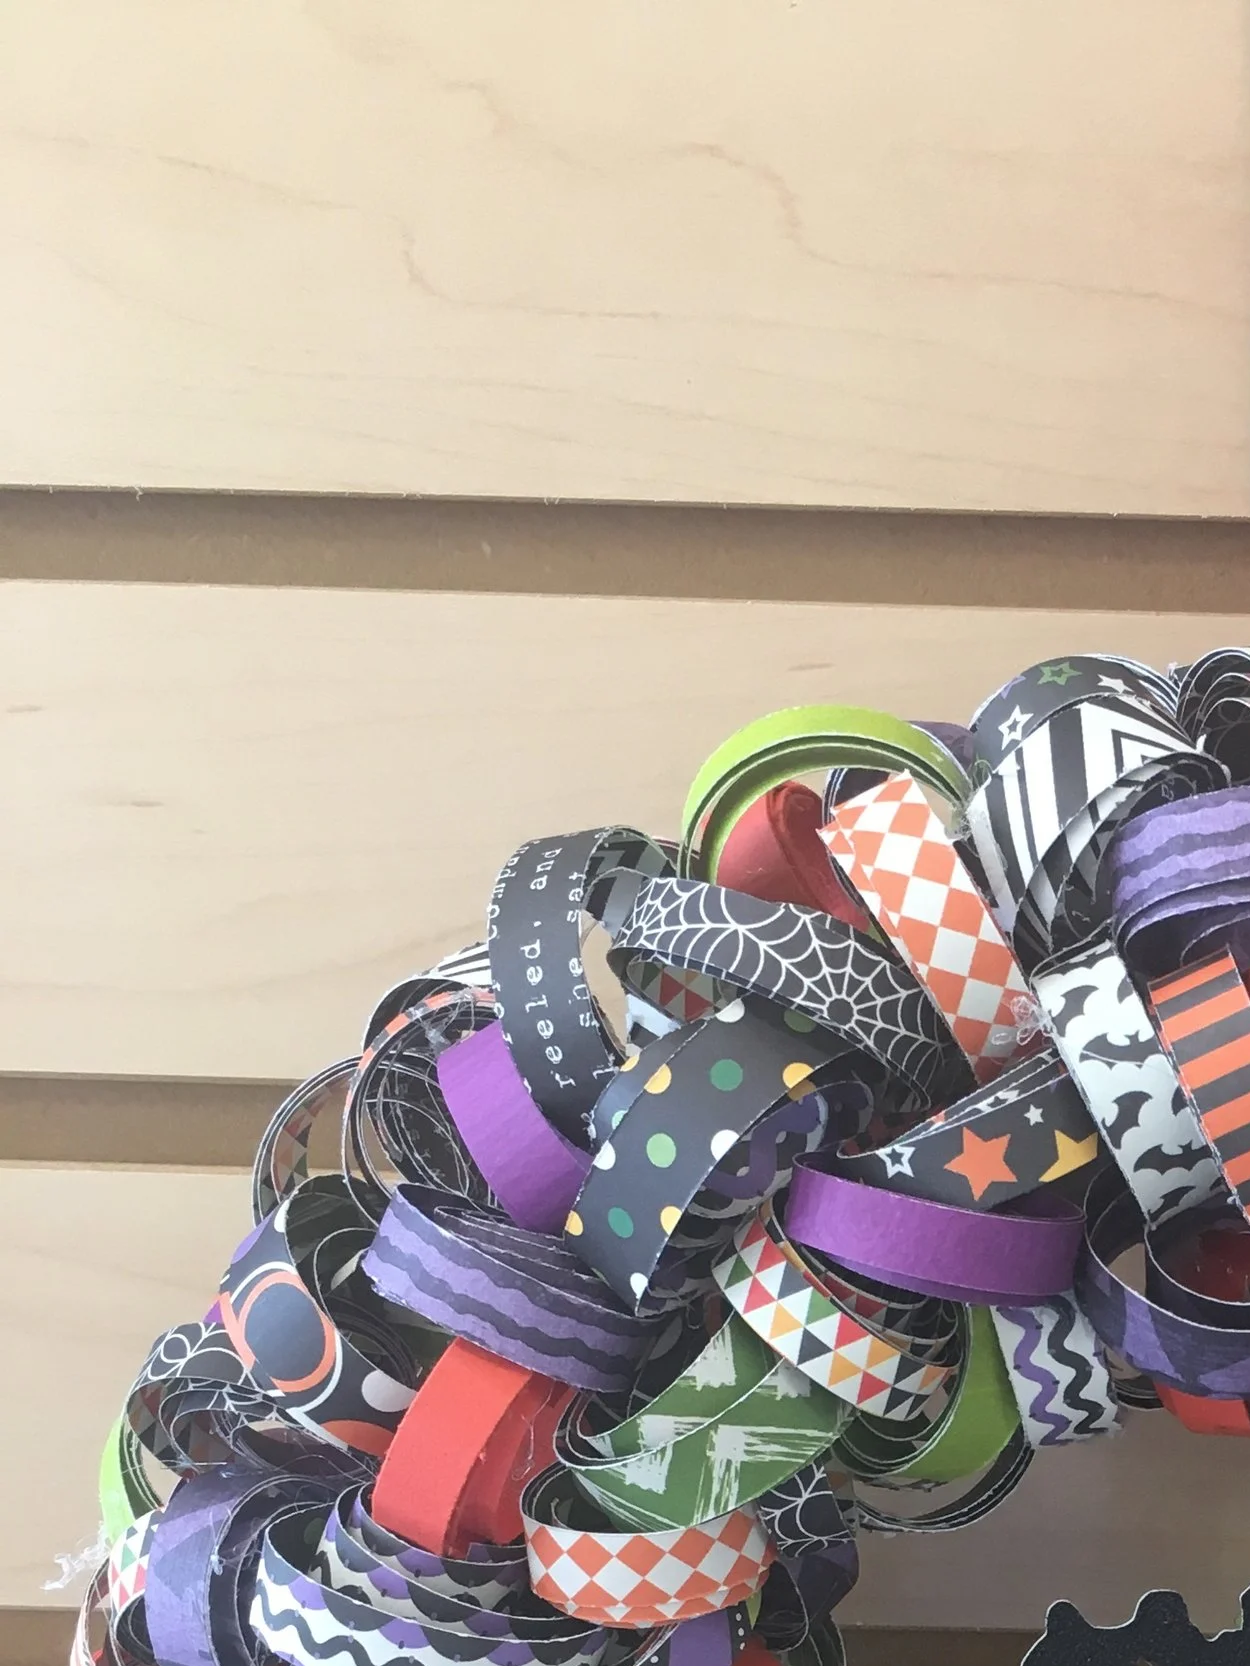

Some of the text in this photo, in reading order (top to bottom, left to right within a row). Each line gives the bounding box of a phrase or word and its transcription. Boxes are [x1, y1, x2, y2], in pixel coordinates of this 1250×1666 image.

[520, 846, 577, 1088] reeled, and
[566, 870, 589, 924] sat
